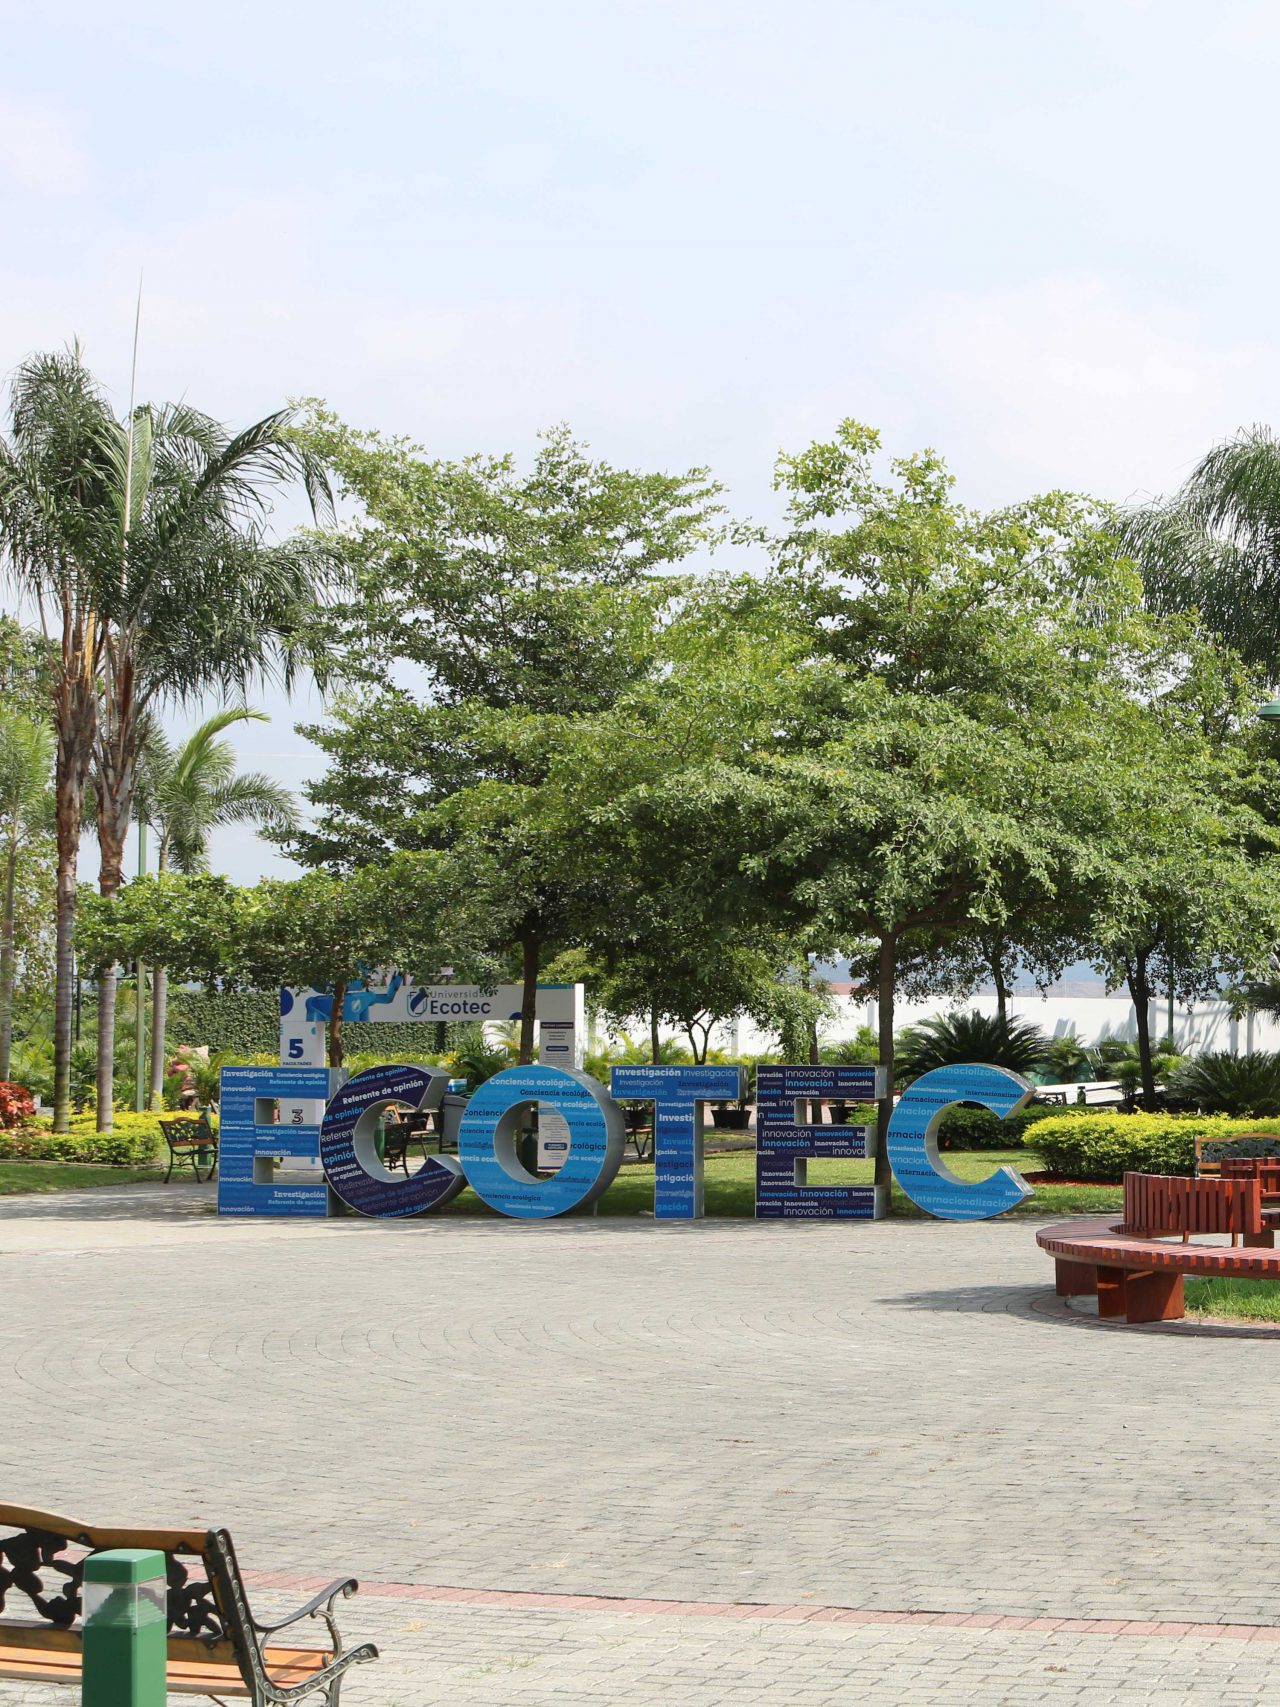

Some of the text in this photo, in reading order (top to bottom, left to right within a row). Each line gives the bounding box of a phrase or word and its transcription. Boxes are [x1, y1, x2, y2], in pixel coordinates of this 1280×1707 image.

[430, 1000, 491, 1014] Ecotec
[287, 1039, 304, 1059] 5
[223, 1070, 274, 1079] Investigación
[615, 1068, 739, 1080] Investigación Investigación
[785, 1069, 835, 1078] innovación
[489, 1078, 576, 1088] Conciencia ecológica
[619, 1079, 664, 1088] Investigación
[342, 1091, 381, 1105] Referente
[381, 1088, 392, 1096] de
[393, 1079, 424, 1093] opinión
[291, 1108, 304, 1125] 3
[335, 1104, 365, 1119] opinión
[762, 1128, 812, 1138] innovación
[218, 1063, 1036, 1220] ECOTEC
[273, 1191, 326, 1200] Investigación
[783, 1206, 834, 1216] innovación
